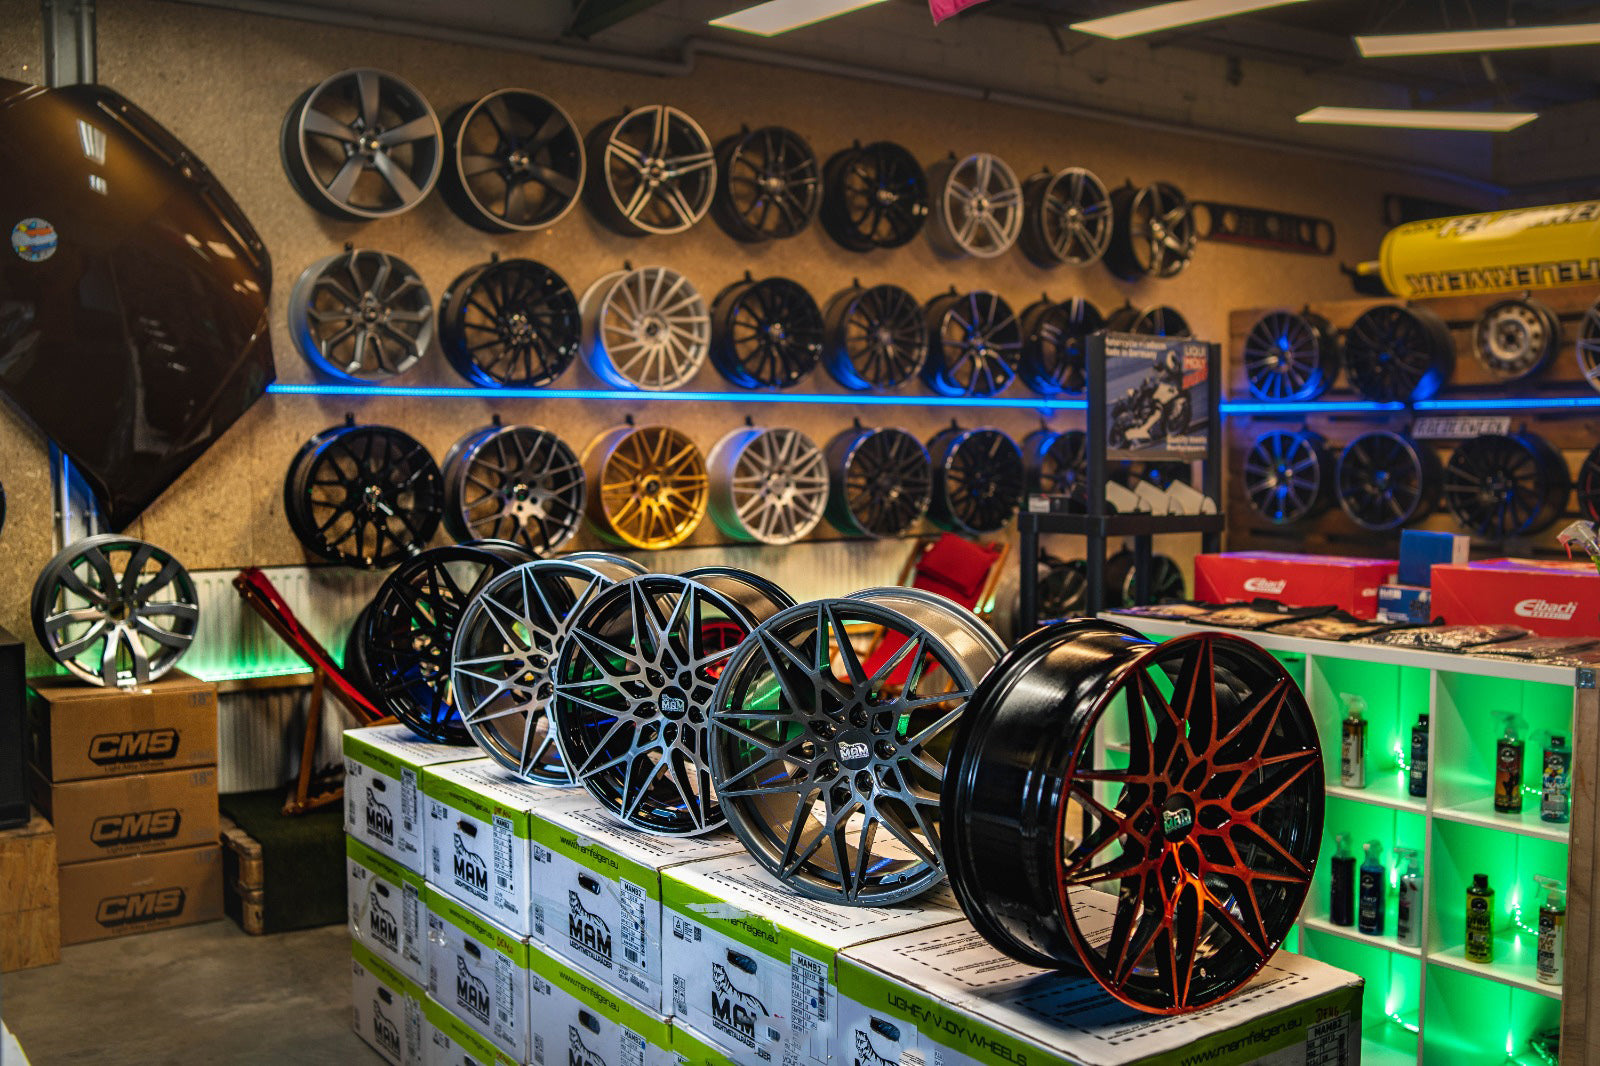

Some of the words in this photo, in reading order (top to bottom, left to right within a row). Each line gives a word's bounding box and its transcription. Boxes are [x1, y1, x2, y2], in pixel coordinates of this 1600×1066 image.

[1404, 260, 1600, 297] FEUERWERK
[1243, 577, 1287, 594] Eibach
[1514, 599, 1577, 620] Eibach
[90, 730, 175, 760] CMS
[92, 810, 178, 843] CMS
[367, 807, 394, 839] MAM
[454, 854, 488, 892] MAM
[98, 888, 183, 923] CMS
[370, 910, 398, 945] MAM
[568, 913, 613, 959] MAM
[797, 956, 822, 975] MAMB2
[456, 975, 490, 1018] MAM
[373, 1017, 400, 1053] MAM
